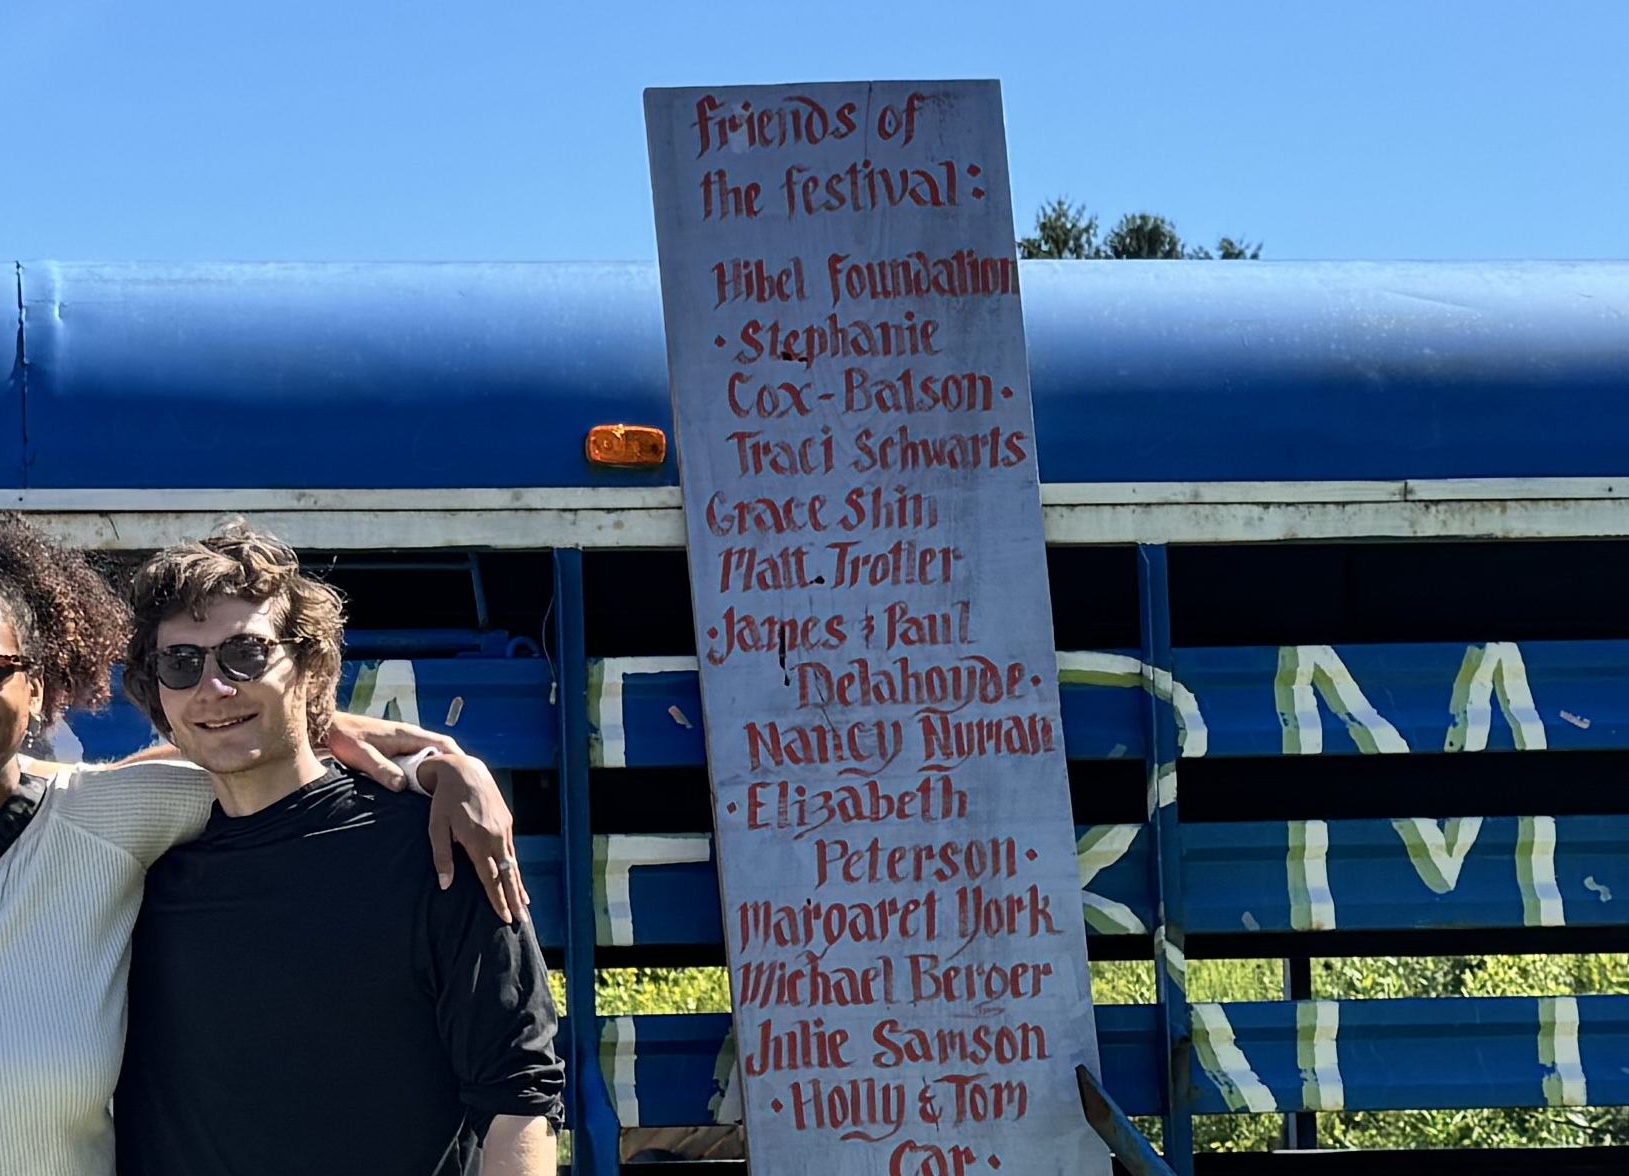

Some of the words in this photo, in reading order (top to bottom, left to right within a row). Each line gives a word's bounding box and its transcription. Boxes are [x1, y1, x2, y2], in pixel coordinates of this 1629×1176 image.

[877, 92, 927, 149] of
[700, 168, 764, 221] the
[725, 425, 835, 478] Traci
[849, 424, 1028, 473] Schwarts
[706, 490, 827, 538] Grace
[837, 485, 939, 532] Shin
[718, 545, 812, 593] Matt
[826, 539, 964, 590] Trotter
[883, 600, 979, 651] Paul
[744, 718, 904, 777] Nancy
[747, 774, 969, 840] Elizabeth
[588, 641, 1589, 1127] FRM
[814, 837, 1018, 889] Peterson
[738, 890, 942, 965] Margaret
[945, 884, 1065, 962] York
[738, 952, 895, 1008] Michael
[904, 953, 1053, 1016] Berger
[745, 1018, 857, 1077] Julie
[872, 1018, 1053, 1069] Samson
[789, 1077, 905, 1143] Holly
[933, 1073, 1027, 1129] Tom
